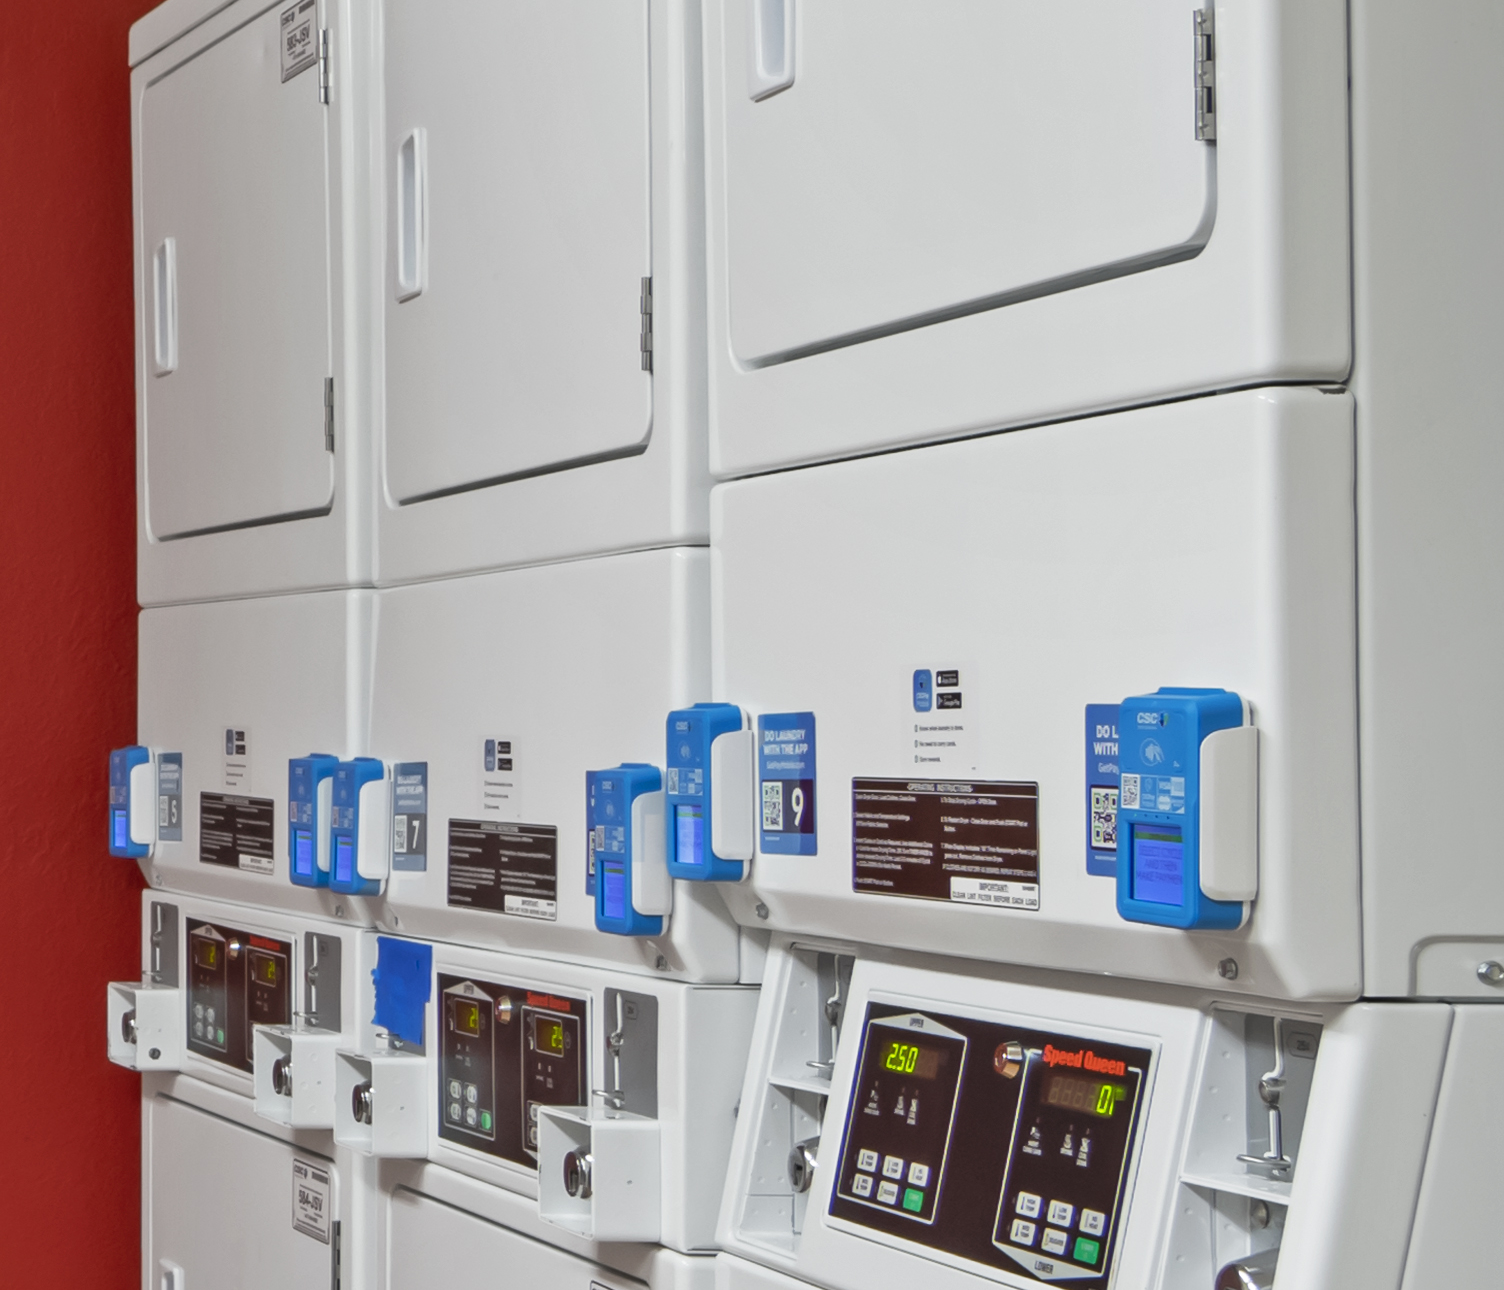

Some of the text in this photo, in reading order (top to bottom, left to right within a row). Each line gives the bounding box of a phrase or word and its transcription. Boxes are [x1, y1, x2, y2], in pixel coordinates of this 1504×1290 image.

[1137, 712, 1158, 724] CSC
[1096, 725, 1110, 738] DO
[1093, 742, 1118, 756] WITH
[791, 787, 804, 826] 9
[412, 820, 420, 849] 7
[886, 1043, 919, 1073] 2.50
[1043, 1044, 1126, 1076] Speed Queen
[1034, 1259, 1054, 1275] LOWER
